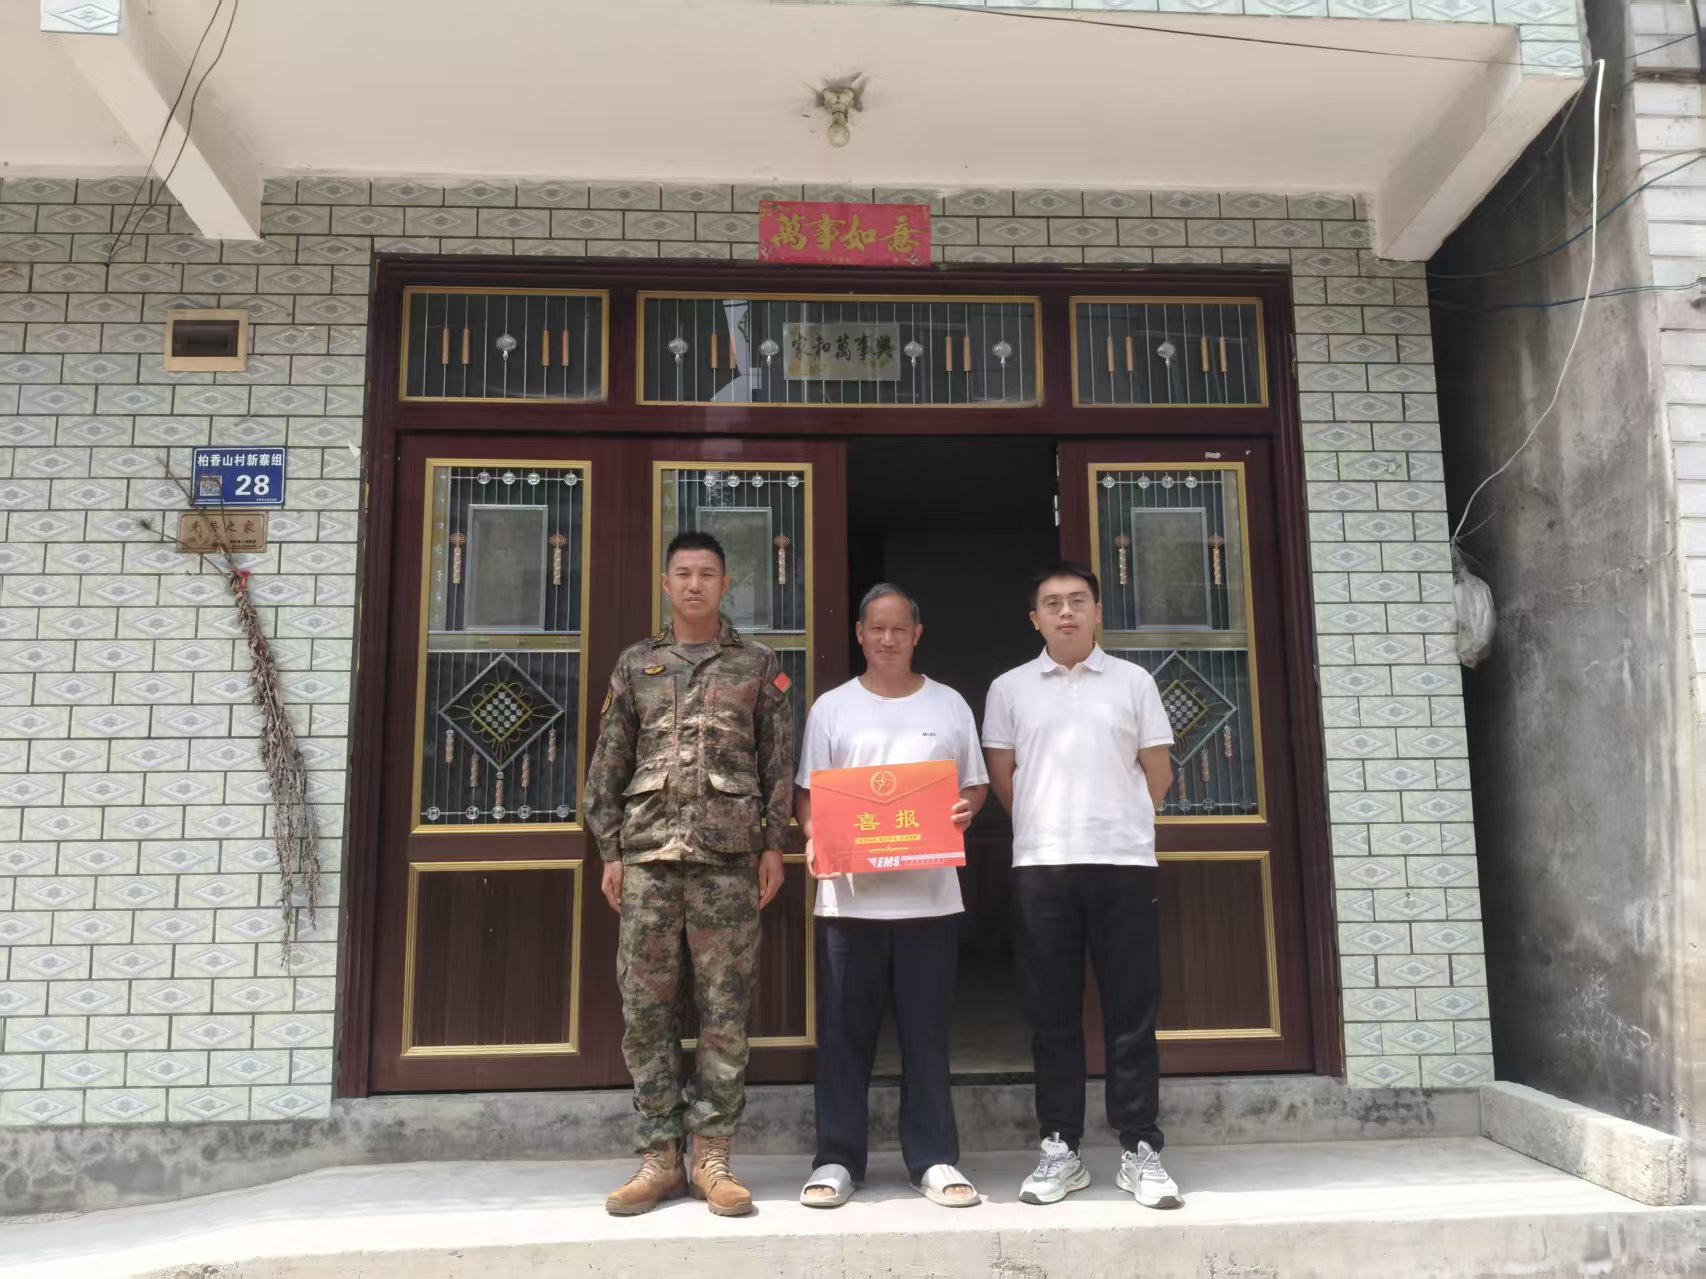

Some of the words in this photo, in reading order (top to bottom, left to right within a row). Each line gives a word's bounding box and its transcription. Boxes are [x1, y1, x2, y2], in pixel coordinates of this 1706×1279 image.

[770, 213, 928, 253] 萬事如意
[197, 453, 282, 467] 柏香山村新寨组
[235, 474, 270, 496] 28
[853, 809, 920, 831] 喜报
[876, 856, 901, 869] EMS
